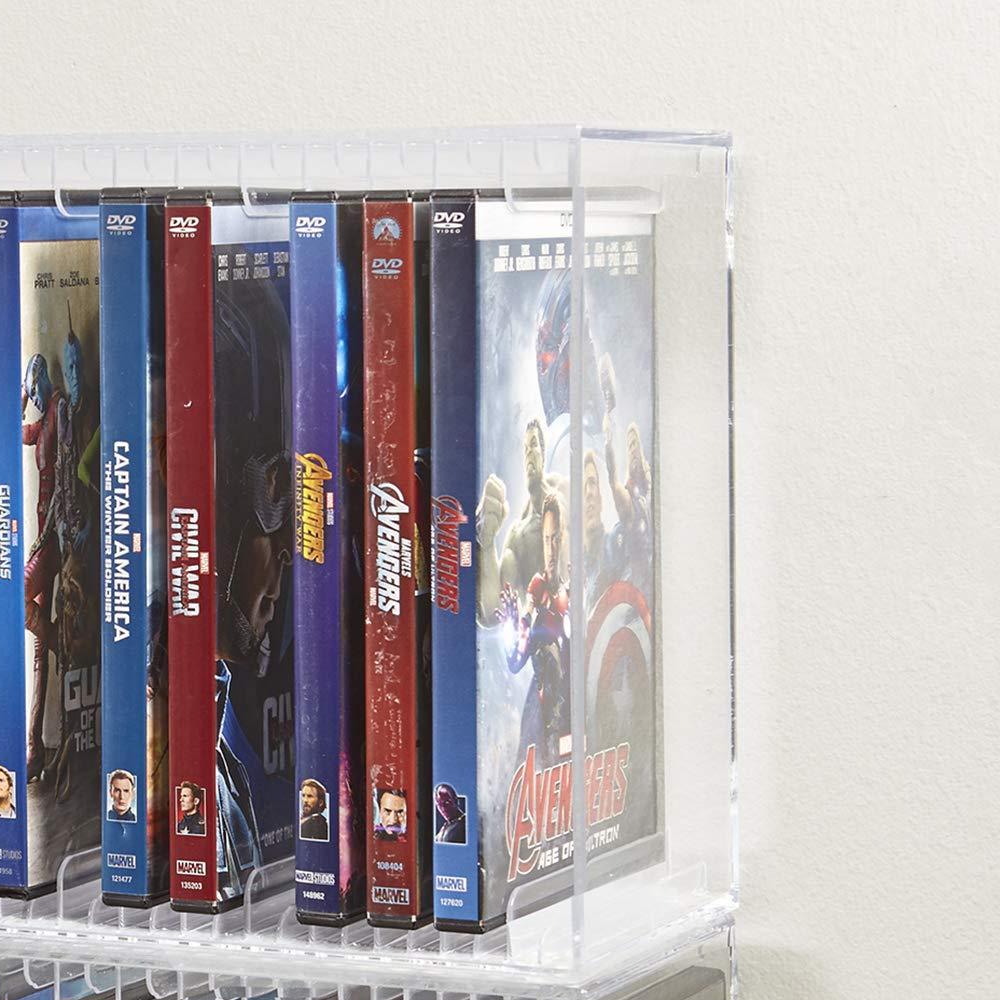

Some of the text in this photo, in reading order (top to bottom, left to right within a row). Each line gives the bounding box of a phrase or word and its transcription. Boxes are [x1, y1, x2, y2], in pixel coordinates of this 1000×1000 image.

[107, 215, 136, 224] DVD
[169, 217, 199, 226] DVD
[295, 217, 326, 226] DVD
[433, 212, 465, 222] DVD
[372, 258, 403, 268] DVD
[34, 278, 89, 288] PRATT SALDANA
[295, 452, 332, 564] AVENGERS
[0, 485, 11, 580] GUARDIANS
[114, 441, 130, 642] CAPTAIN AMERICA
[369, 482, 409, 615] AVENGERS
[432, 495, 468, 614] AVENGERS
[75, 731, 95, 752] THE
[505, 743, 630, 882] AVENERS
[2, 848, 22, 860] STUDIOS
[108, 853, 136, 868] MARVEL
[538, 849, 559, 869] AGE
[177, 860, 206, 876] MARVEL
[376, 861, 403, 871] 108404
[111, 875, 133, 883] 121477
[296, 870, 335, 885] MARVEL STUDIOS
[436, 876, 467, 892] MARVEL
[181, 882, 202, 890] 135203
[372, 886, 409, 905] MARVEL
